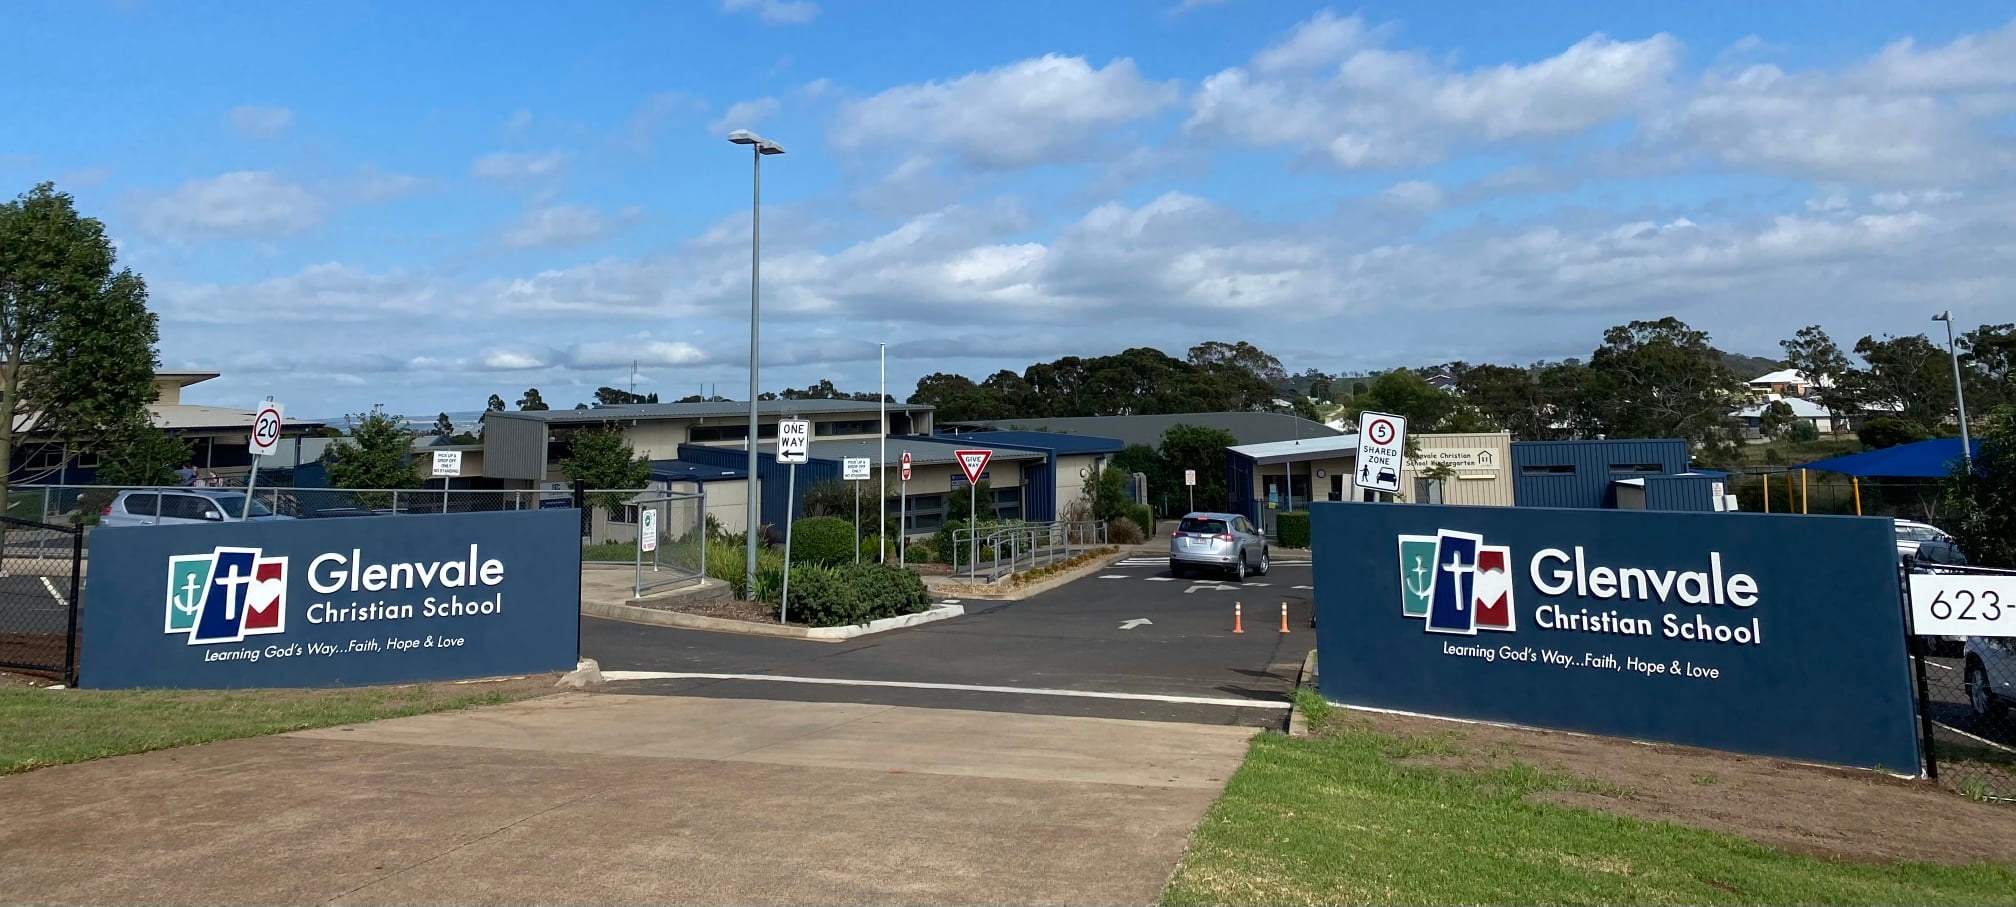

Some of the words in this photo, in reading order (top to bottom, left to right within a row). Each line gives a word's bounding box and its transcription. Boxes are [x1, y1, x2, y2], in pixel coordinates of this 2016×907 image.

[257, 418, 277, 438] 20
[784, 424, 804, 434] ONE
[1378, 425, 1386, 437] 5
[782, 437, 804, 447] WAY
[1363, 445, 1397, 457] SHARED
[1368, 455, 1390, 465] ZONE
[307, 543, 505, 594] Glenvale
[1530, 546, 1759, 607] Glenvale
[306, 600, 413, 624] Christian
[423, 593, 501, 618] School
[1535, 604, 1652, 636] Christian
[1663, 613, 1761, 644] School
[204, 647, 260, 662] Learning
[264, 643, 302, 658] God's
[386, 637, 420, 652] Hope
[423, 635, 433, 648] &
[437, 635, 465, 649] Love
[1443, 641, 1495, 662] Learning
[1499, 646, 1537, 662] God's
[1627, 656, 1665, 676] Hope
[1670, 660, 1682, 675] &
[1686, 662, 1719, 679] Love
